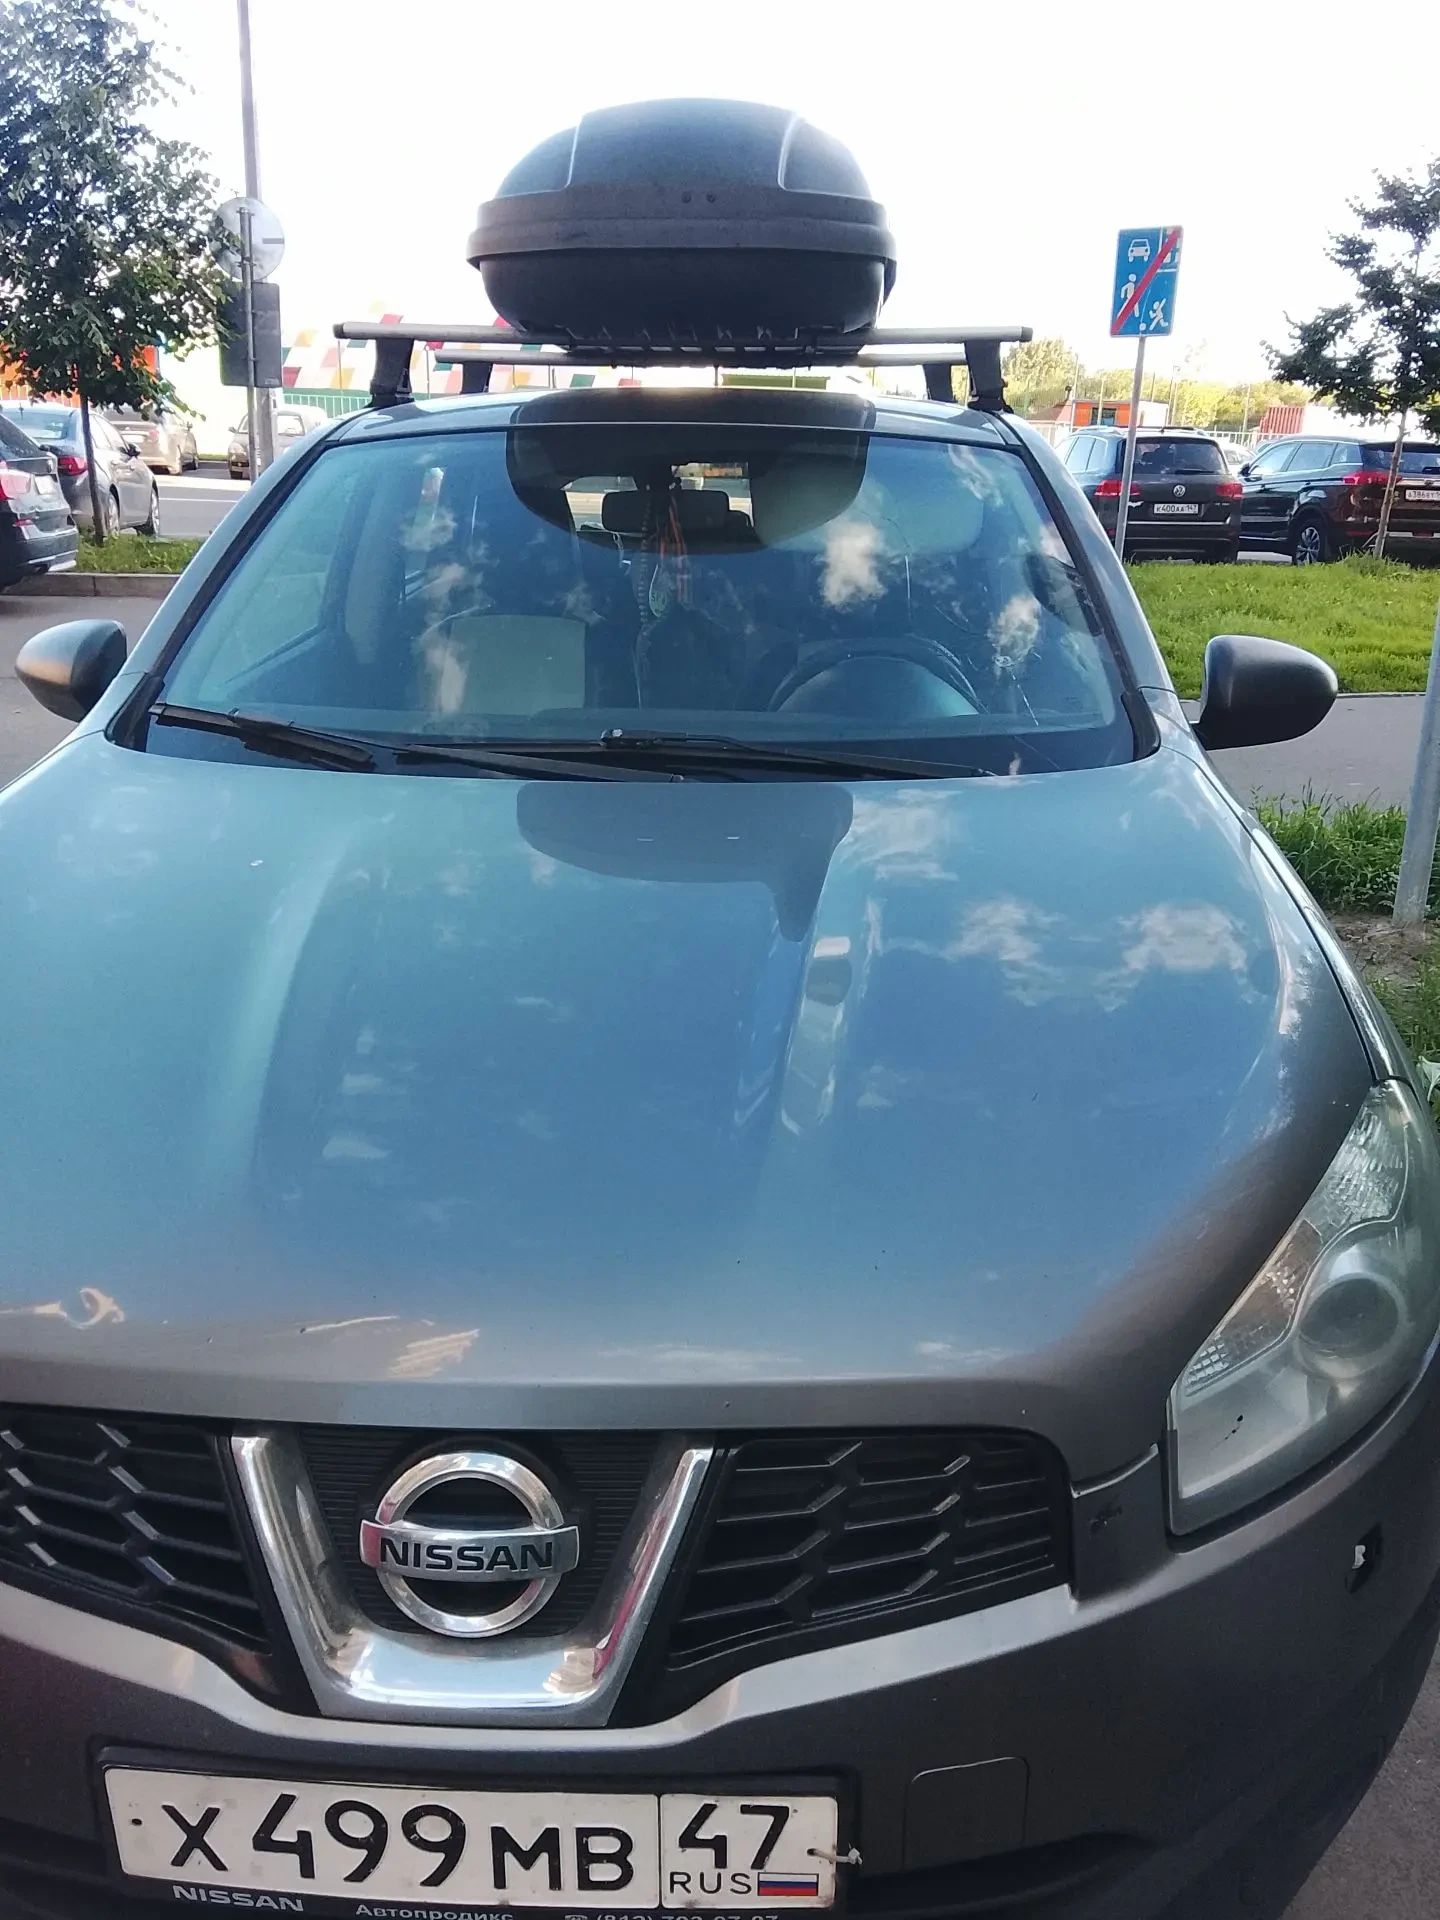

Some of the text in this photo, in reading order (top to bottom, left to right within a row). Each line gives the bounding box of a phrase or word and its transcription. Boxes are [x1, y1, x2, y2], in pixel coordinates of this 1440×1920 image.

[380, 1537, 553, 1572] NISSAN
[678, 1802, 791, 1870] 47
[668, 1871, 752, 1894] RUS
[172, 1884, 304, 1912] NISSAN
[355, 1904, 514, 1920] Автопродикс
